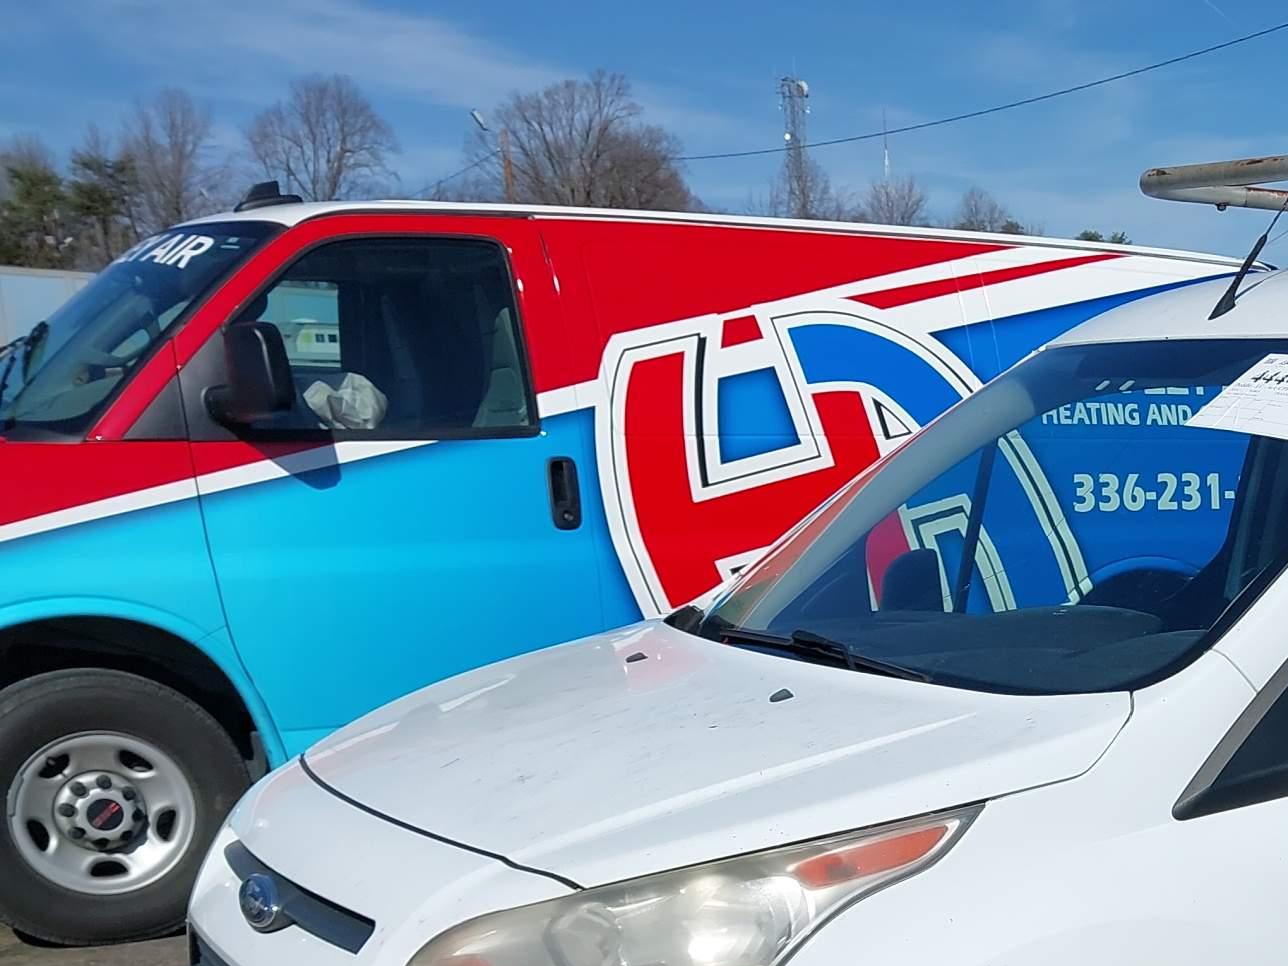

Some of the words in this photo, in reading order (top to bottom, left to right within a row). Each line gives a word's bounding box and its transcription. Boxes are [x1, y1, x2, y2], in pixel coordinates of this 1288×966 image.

[139, 234, 214, 269] AIR
[1146, 404, 1193, 425] AND
[1073, 472, 1241, 513] 336-231-
